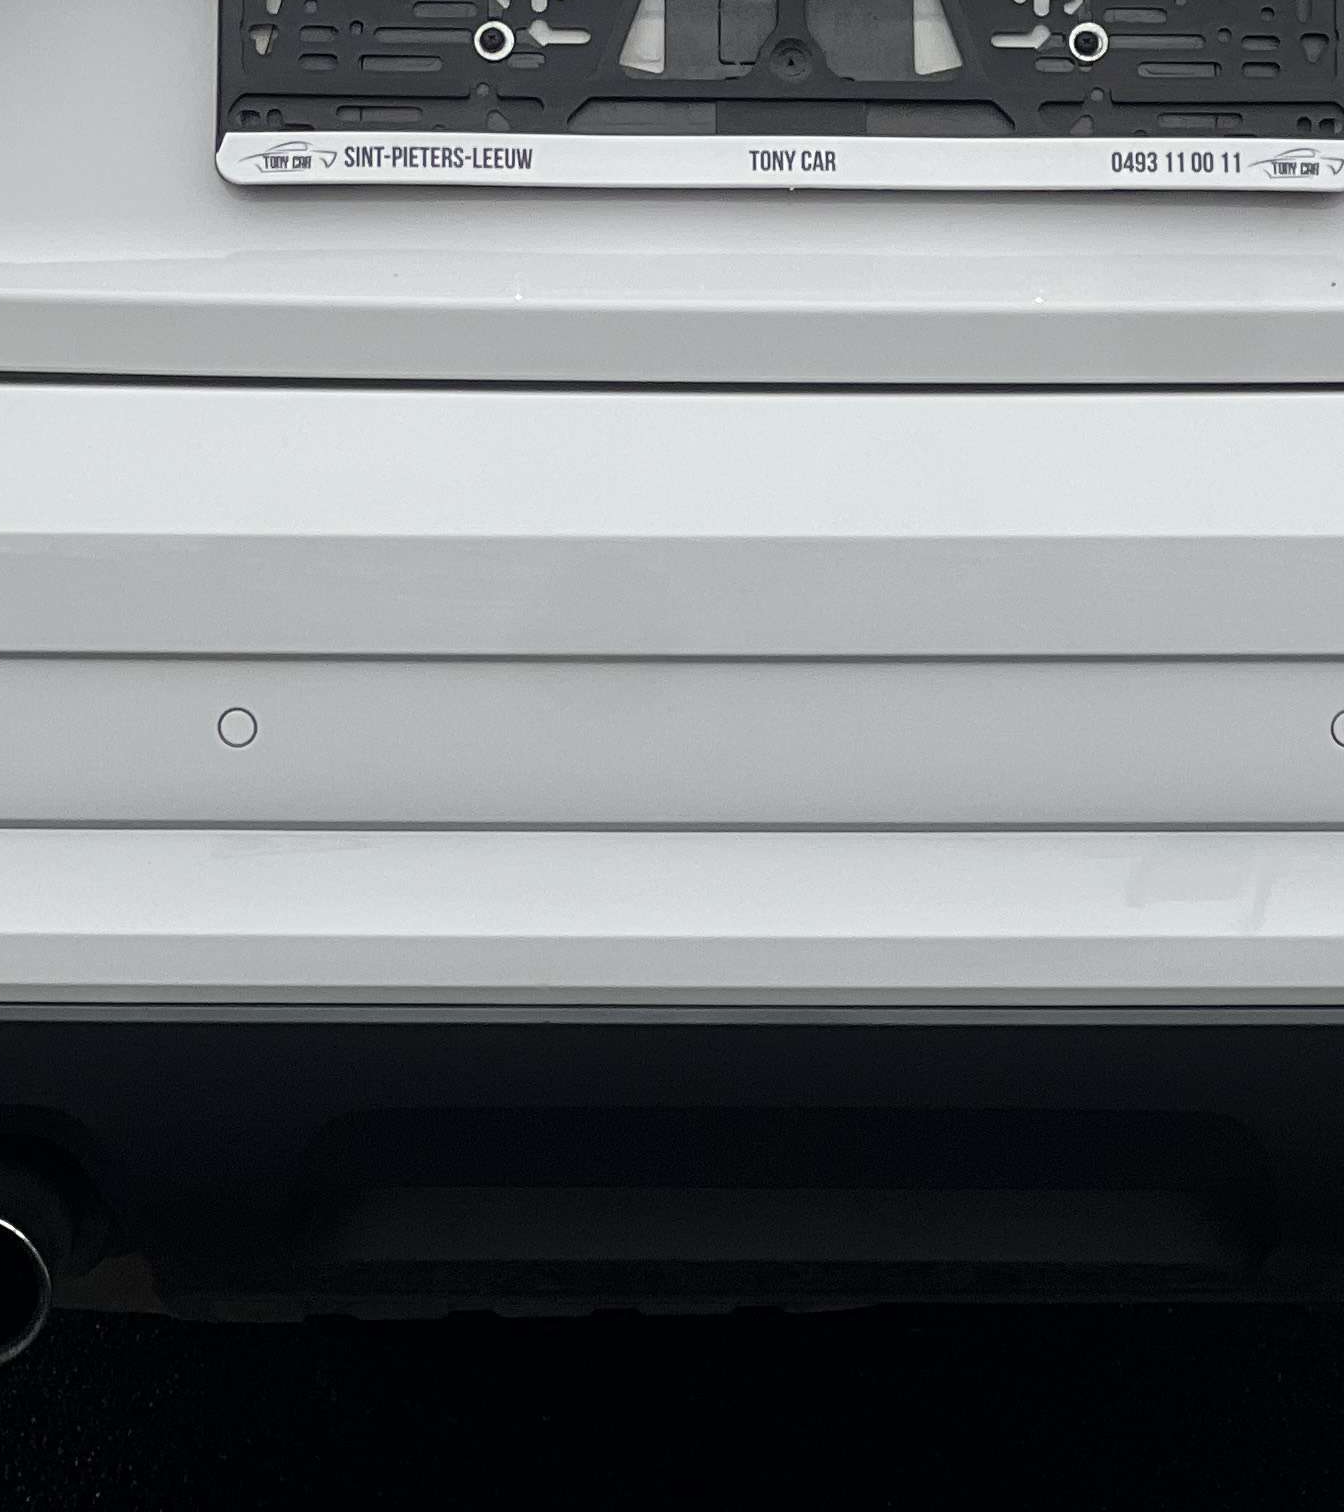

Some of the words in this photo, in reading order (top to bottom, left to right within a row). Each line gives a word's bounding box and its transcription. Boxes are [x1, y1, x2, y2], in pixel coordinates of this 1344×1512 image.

[344, 146, 533, 170] SINT-PIETERS-LEEUW
[749, 150, 796, 172] TONY
[801, 150, 837, 172] CAR
[1111, 152, 1157, 173] 0493
[1165, 152, 1185, 173] 11
[1191, 152, 1213, 173] 00
[1221, 153, 1241, 174] 11
